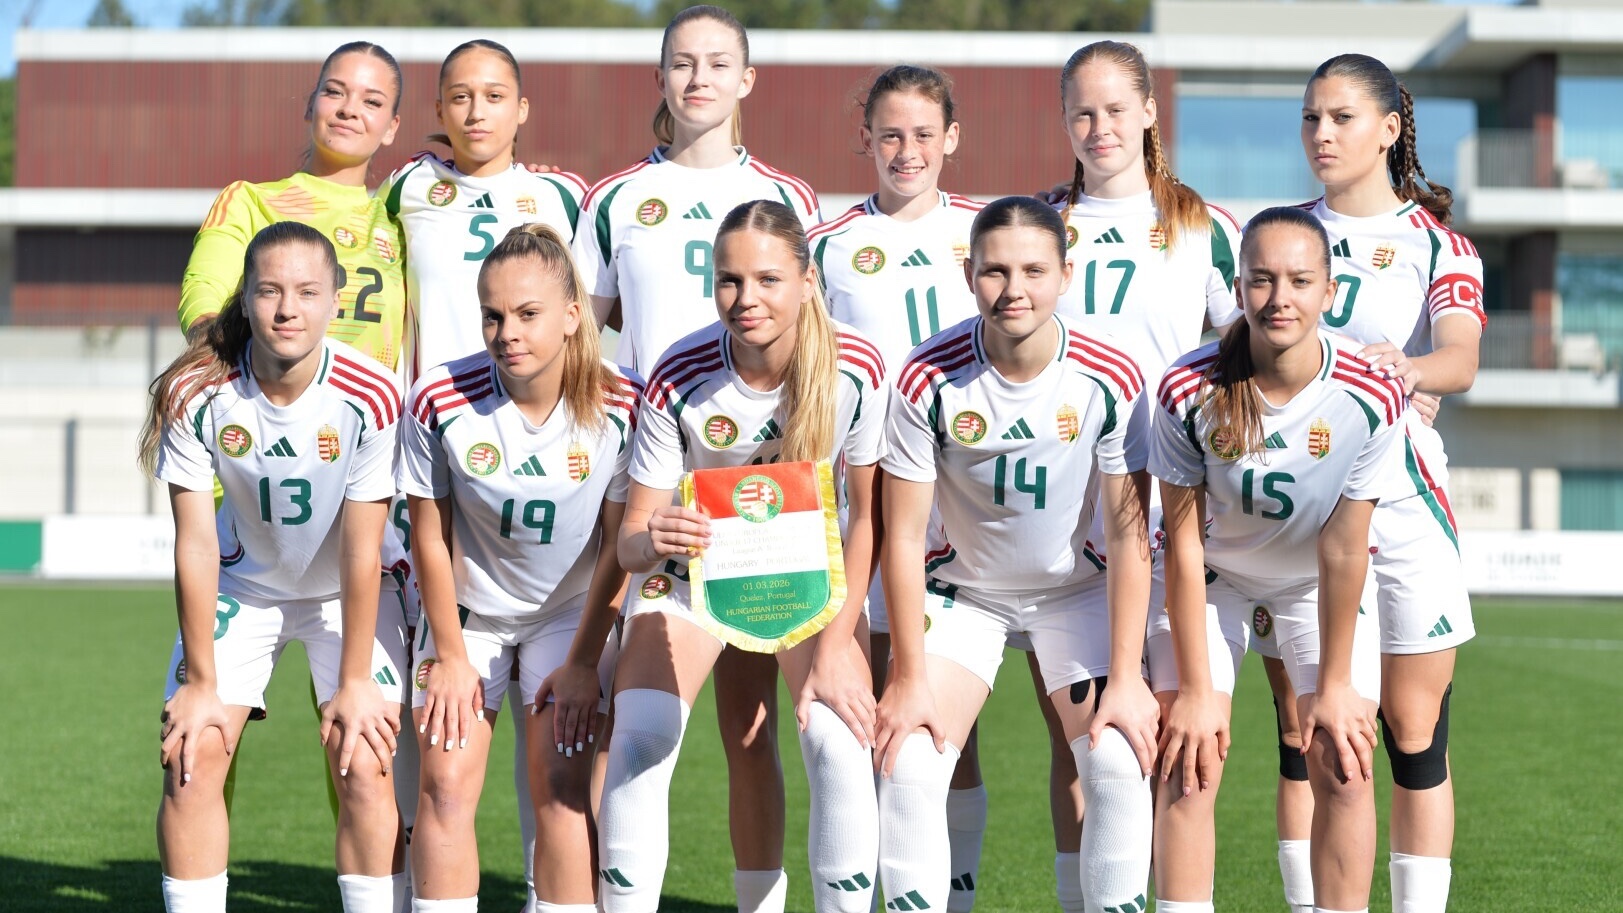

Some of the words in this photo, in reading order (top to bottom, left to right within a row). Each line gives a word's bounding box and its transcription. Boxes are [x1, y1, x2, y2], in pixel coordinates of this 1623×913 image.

[463, 214, 499, 261] 5
[684, 239, 713, 298] 9
[1084, 259, 1137, 315] 17
[904, 285, 941, 347] 11
[1452, 280, 1476, 307] C
[258, 476, 313, 526] 13
[993, 454, 1047, 510] 14
[1241, 468, 1296, 521] 15
[499, 498, 556, 545] 19
[716, 559, 760, 571] HUNGARY
[742, 579, 791, 591] 01.03.2026
[726, 604, 771, 616] HUNGARIAN
[772, 601, 812, 612] FOOTBALL
[747, 611, 793, 623] FEDERATION
[767, 589, 797, 600] Portugal
